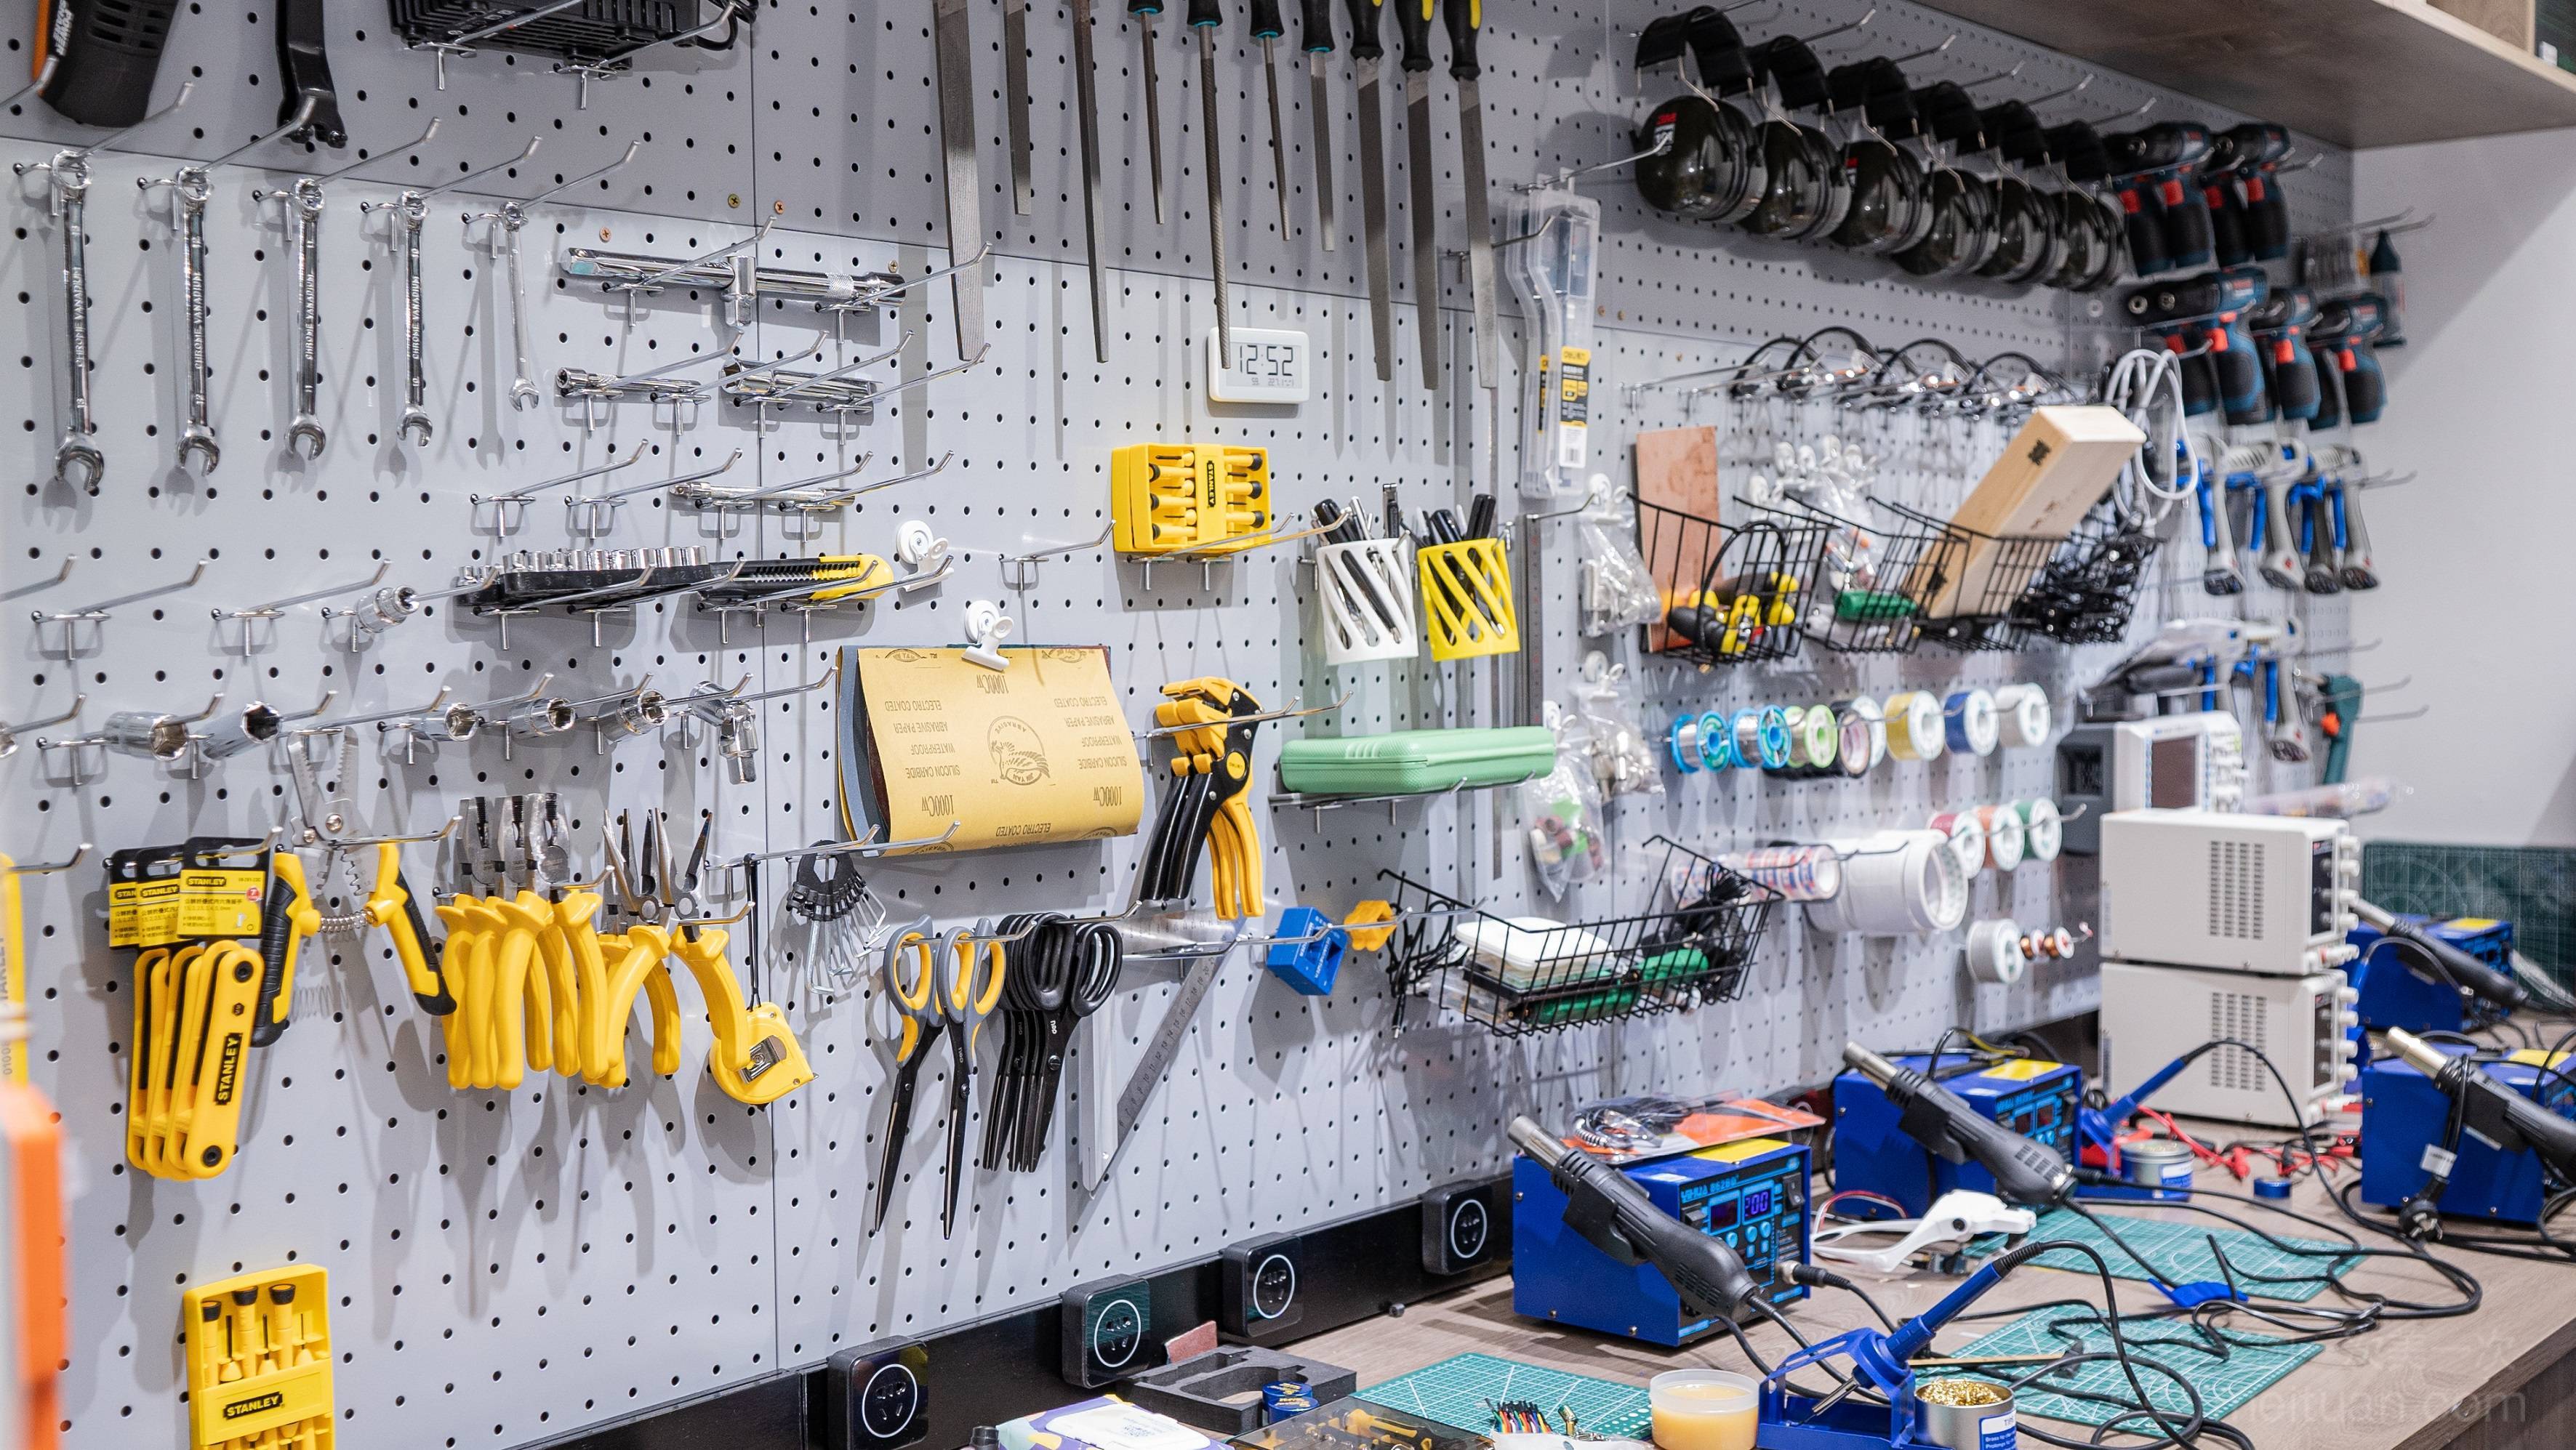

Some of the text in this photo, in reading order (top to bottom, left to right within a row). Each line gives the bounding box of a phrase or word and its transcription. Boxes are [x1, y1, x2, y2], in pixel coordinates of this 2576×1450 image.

[56, 9, 74, 56] POWER
[193, 273, 201, 324] VANADIUM
[305, 274, 314, 319] VANADIUM
[73, 267, 85, 367] CHROME VANADIUM
[1240, 345, 1293, 376] 12:52
[885, 700, 942, 712] ELECTRO COATED
[1054, 696, 1107, 708] ELECTRO COATED
[894, 722, 948, 733] ABRASIVE PAPER
[1065, 716, 1115, 728] ABRASIVE PAPER
[1082, 736, 1123, 747] WATERPROOF
[910, 743, 955, 755] WATERPROOF
[1078, 756, 1127, 769] SILICON CARBIDE
[906, 765, 960, 778] SILICON CARBIDE
[995, 823, 1051, 837] ELECTRO COATED
[142, 886, 179, 897] STANLEY
[217, 1037, 238, 1100] STANLEY
[227, 1395, 280, 1417] STANLEY
